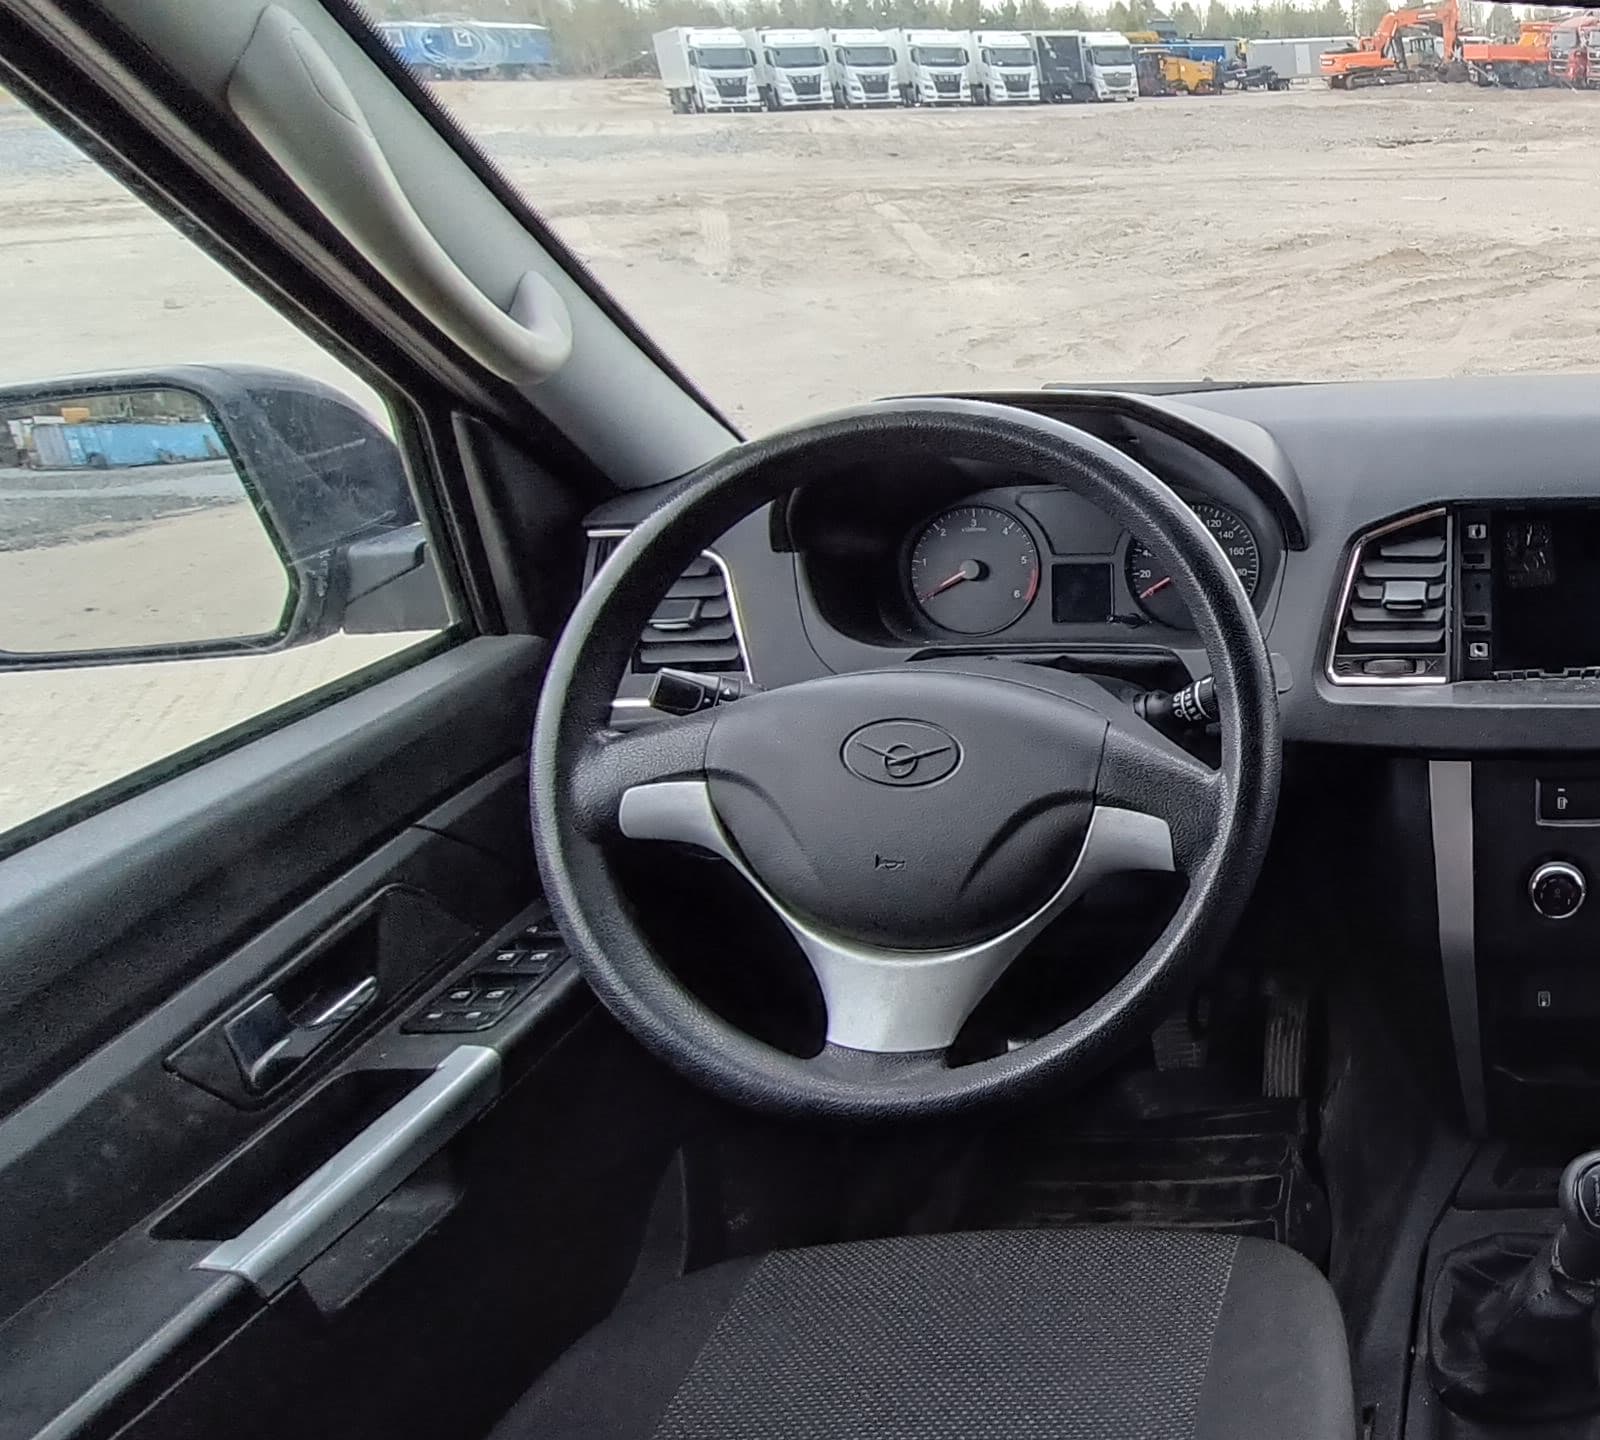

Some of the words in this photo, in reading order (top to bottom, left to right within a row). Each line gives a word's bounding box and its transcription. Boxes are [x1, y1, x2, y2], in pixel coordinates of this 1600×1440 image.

[971, 519, 977, 528] 3
[1206, 519, 1222, 528] 120
[940, 527, 947, 536] 2
[1002, 527, 1009, 536] 4
[1218, 531, 1234, 539] 140
[1228, 547, 1245, 556] 160
[1021, 555, 1027, 564] 5
[1140, 569, 1151, 578] 20
[1013, 589, 1020, 598] 6
